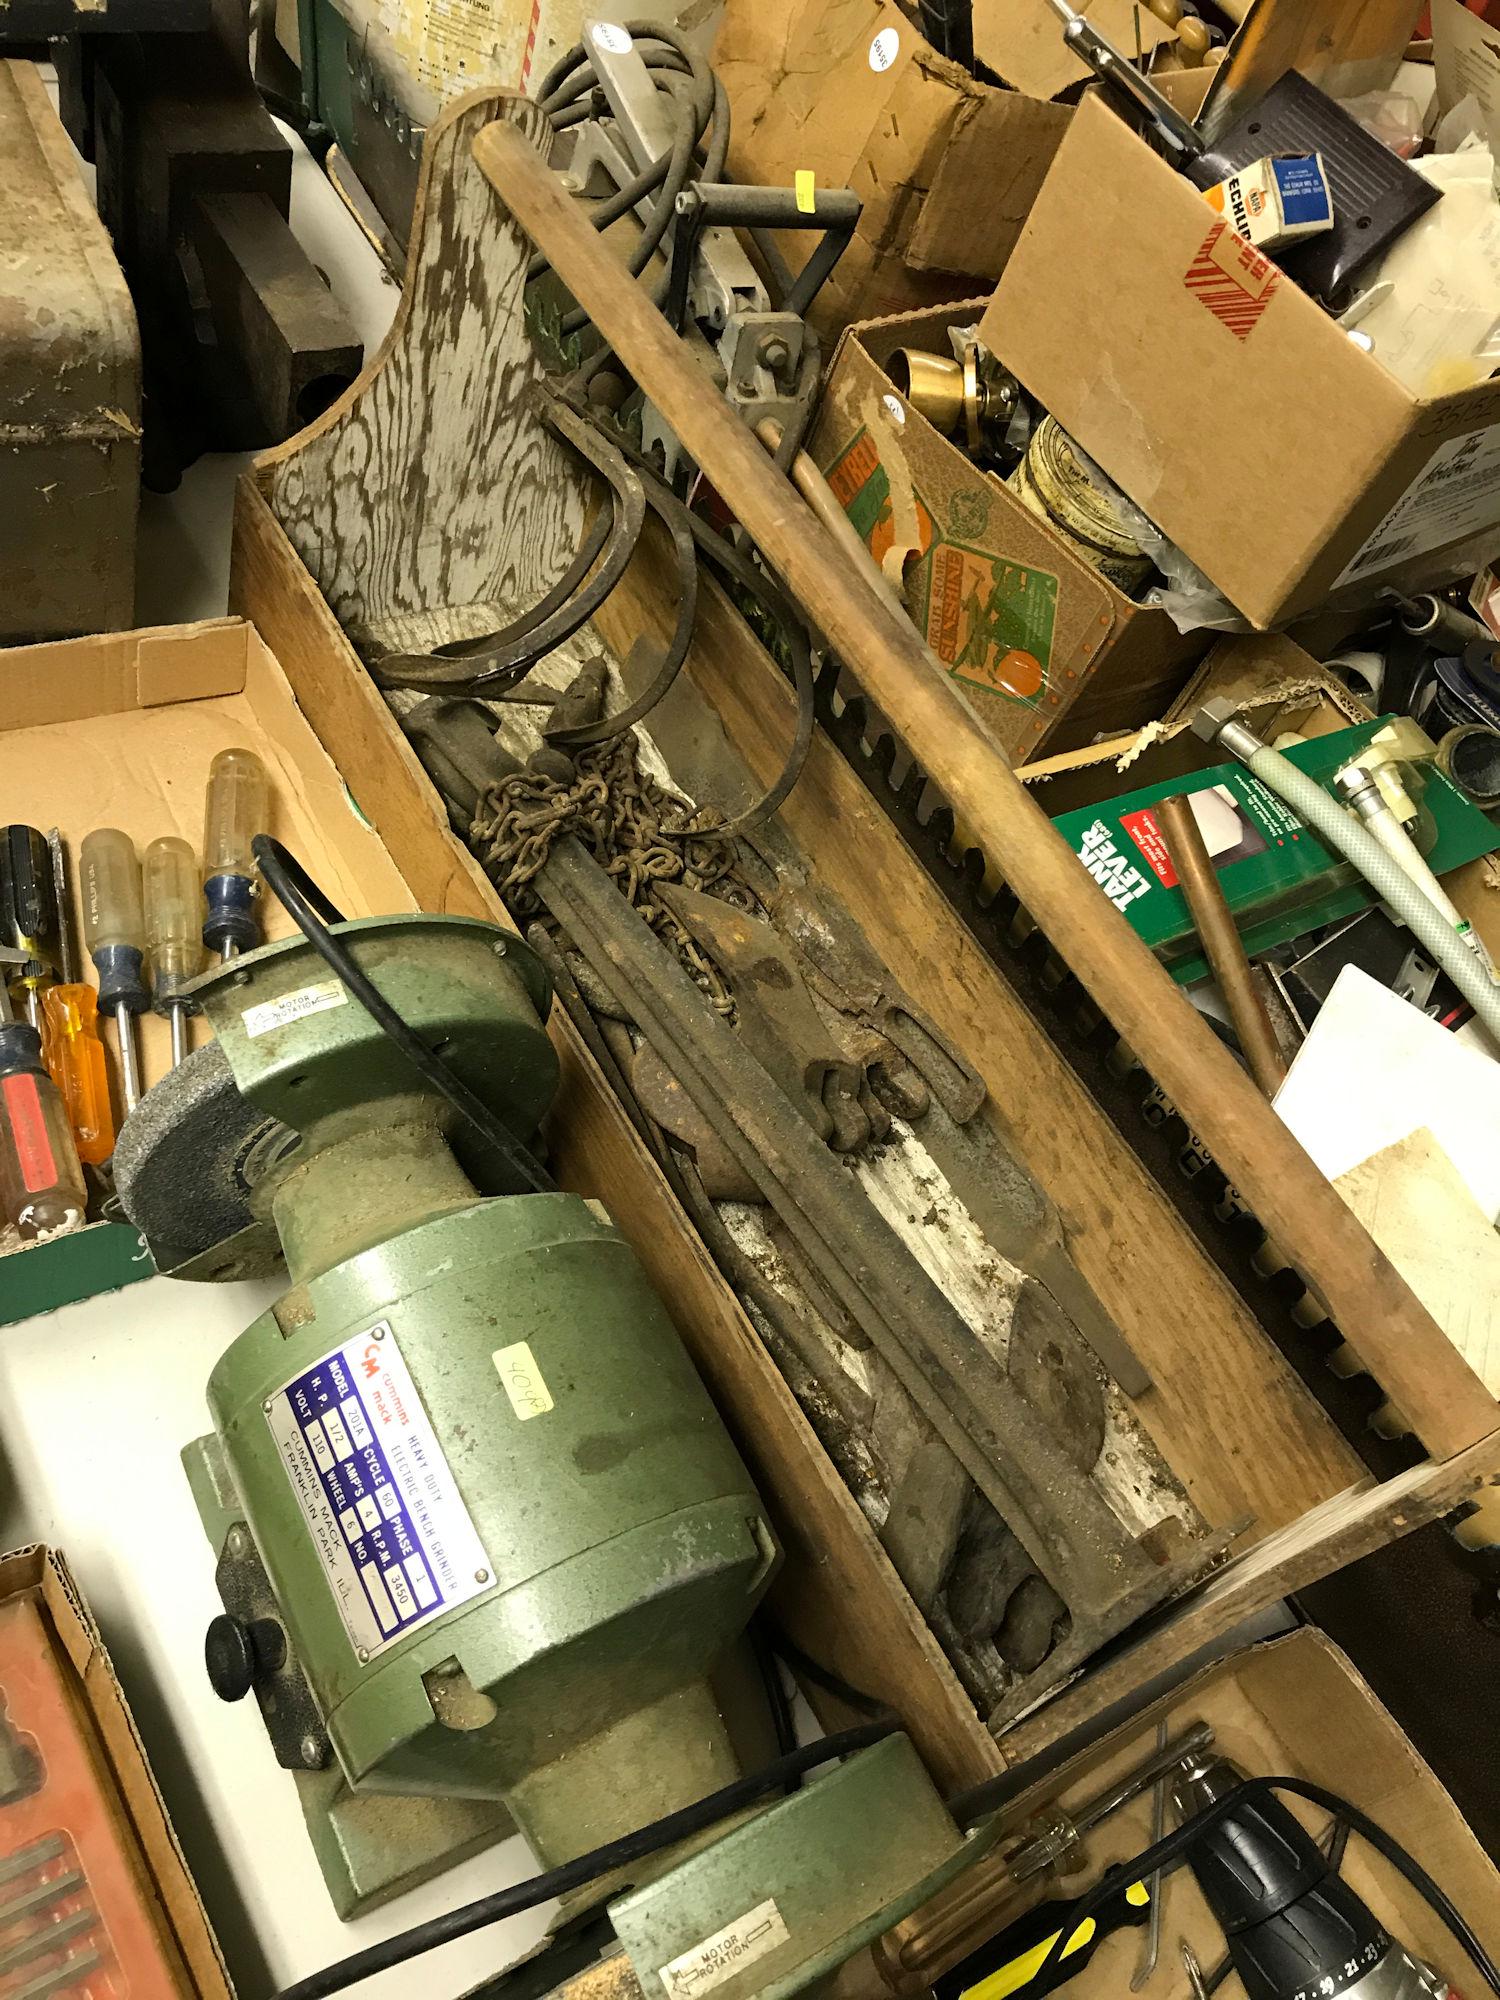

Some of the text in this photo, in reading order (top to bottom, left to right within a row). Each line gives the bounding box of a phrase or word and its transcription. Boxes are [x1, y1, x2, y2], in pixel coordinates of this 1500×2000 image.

[1250, 191, 1262, 214] NAPA
[929, 553, 947, 650] GRAB SOME
[939, 548, 965, 664] SUNSHINE
[1467, 692, 1500, 725] PLUM
[1131, 825, 1168, 875] Fits most front,
[1142, 815, 1158, 836] tanks.
[1143, 834, 1167, 861] side and
[1077, 843, 1135, 913] TANK
[1081, 823, 1152, 899] LEVER
[279, 995, 310, 1009] MOTOR
[372, 1390, 391, 1425] mack
[381, 1373, 410, 1427] cummins
[290, 1430, 343, 1549] CUMMINS MACK
[294, 1389, 367, 1565] VOLT 110 WHEEL 6 NO.
[328, 1360, 424, 1584] MODEL 201A CYCLE 60 PHASE 1
[408, 1435, 443, 1503] HEAVY DUTY
[283, 1440, 319, 1520] FRANKLIN
[316, 1527, 337, 1570] PARK
[329, 1422, 343, 1444] 1/2
[343, 1462, 364, 1498] AMP'S
[364, 1509, 374, 1520] 4
[371, 1530, 391, 1568] R.P.M.
[390, 1575, 409, 1605] 3450
[390, 1444, 458, 1591] ELECTRIC BENCH GRINDER
[699, 1941, 750, 1979] ROTATION
[701, 1934, 739, 1963] MOTOR
[1320, 1975, 1335, 1996] 19
[1344, 1958, 1360, 1978] 21
